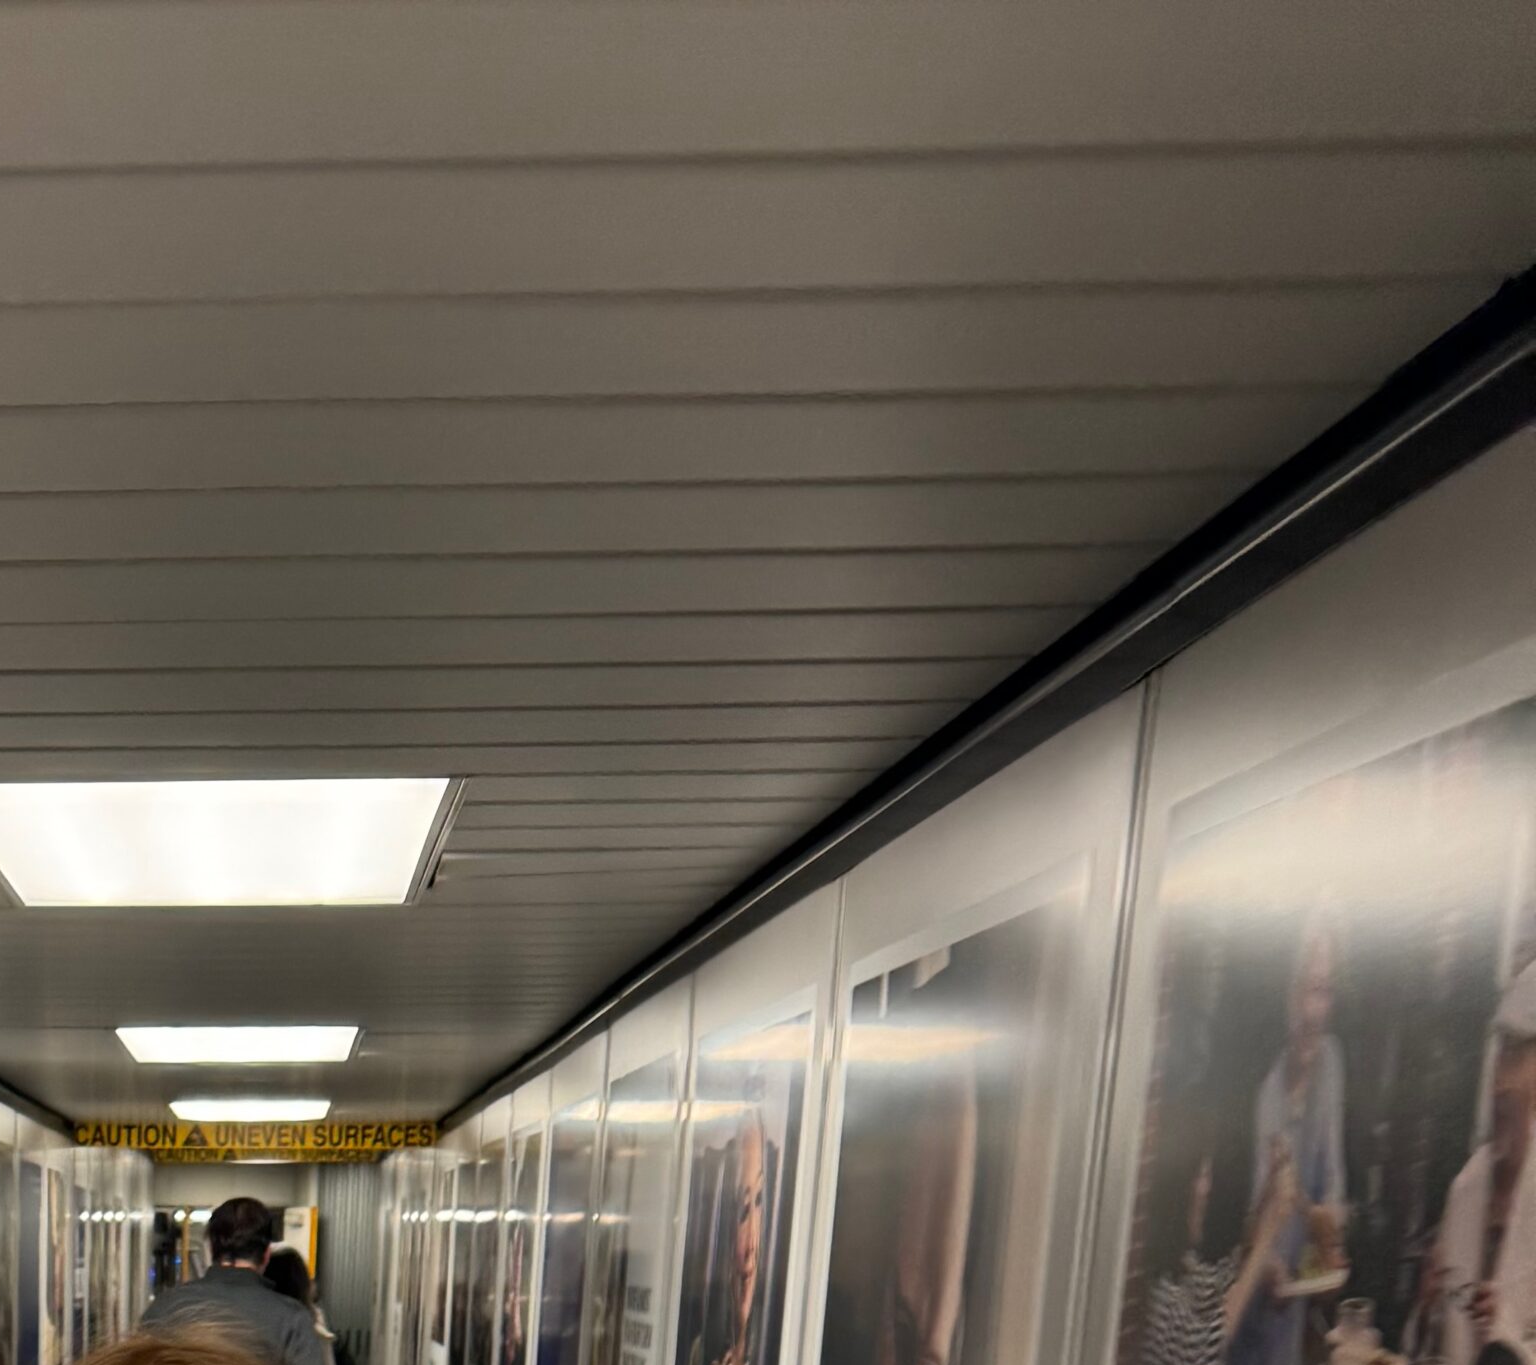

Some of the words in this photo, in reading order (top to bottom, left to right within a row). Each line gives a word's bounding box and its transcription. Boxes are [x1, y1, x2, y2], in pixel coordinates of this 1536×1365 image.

[75, 1124, 177, 1147] CAUTION
[215, 1124, 306, 1147] UNEVEN
[314, 1124, 433, 1148] SURFACES
